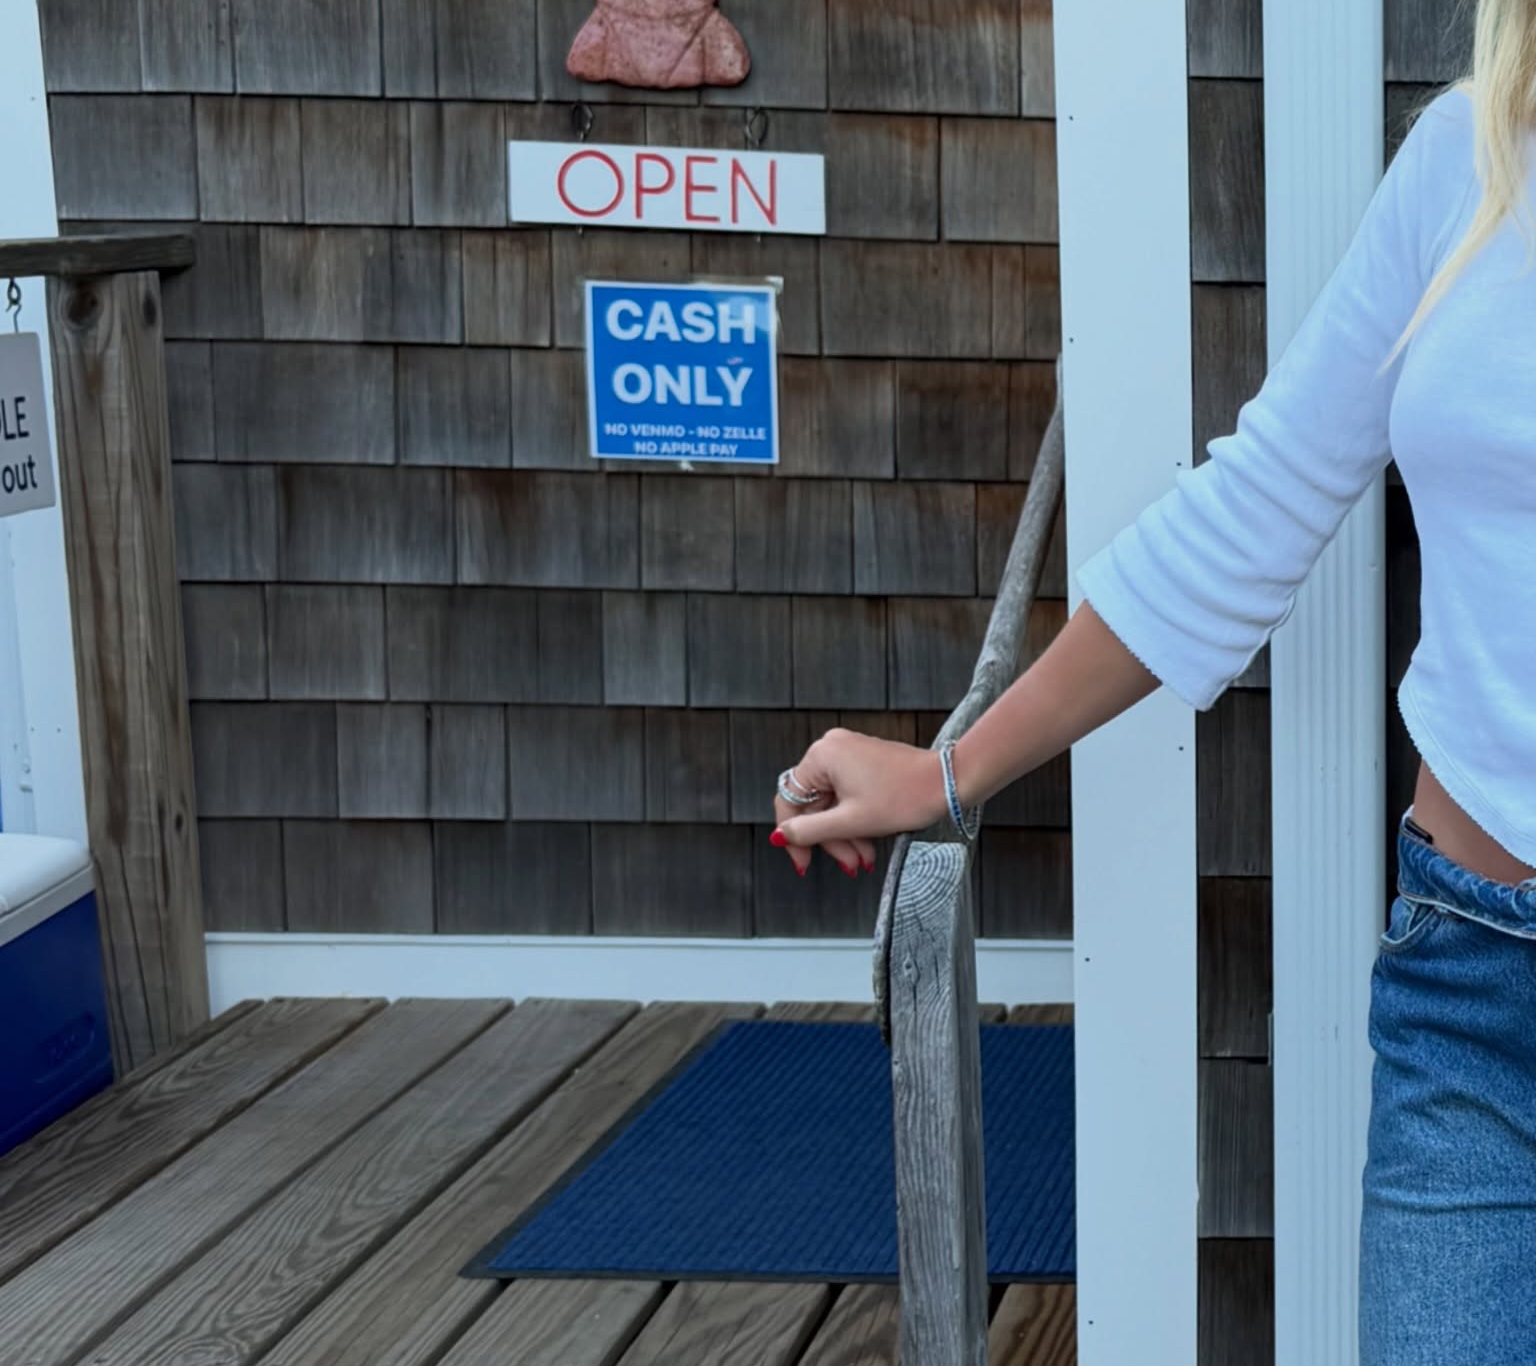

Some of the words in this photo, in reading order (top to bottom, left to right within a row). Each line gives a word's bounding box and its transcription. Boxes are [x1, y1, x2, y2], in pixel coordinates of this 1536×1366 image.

[556, 149, 777, 226] OPEN
[605, 298, 756, 344] CASH
[612, 363, 753, 407] ONLY
[0, 396, 29, 441] LE
[604, 423, 627, 436] NO
[630, 424, 686, 438] VENMO
[696, 426, 721, 440] NO
[723, 426, 766, 441] ZELLE
[634, 441, 658, 455] NO
[660, 442, 707, 456] APPLE
[709, 444, 738, 457] PAY
[2, 455, 38, 494] out
